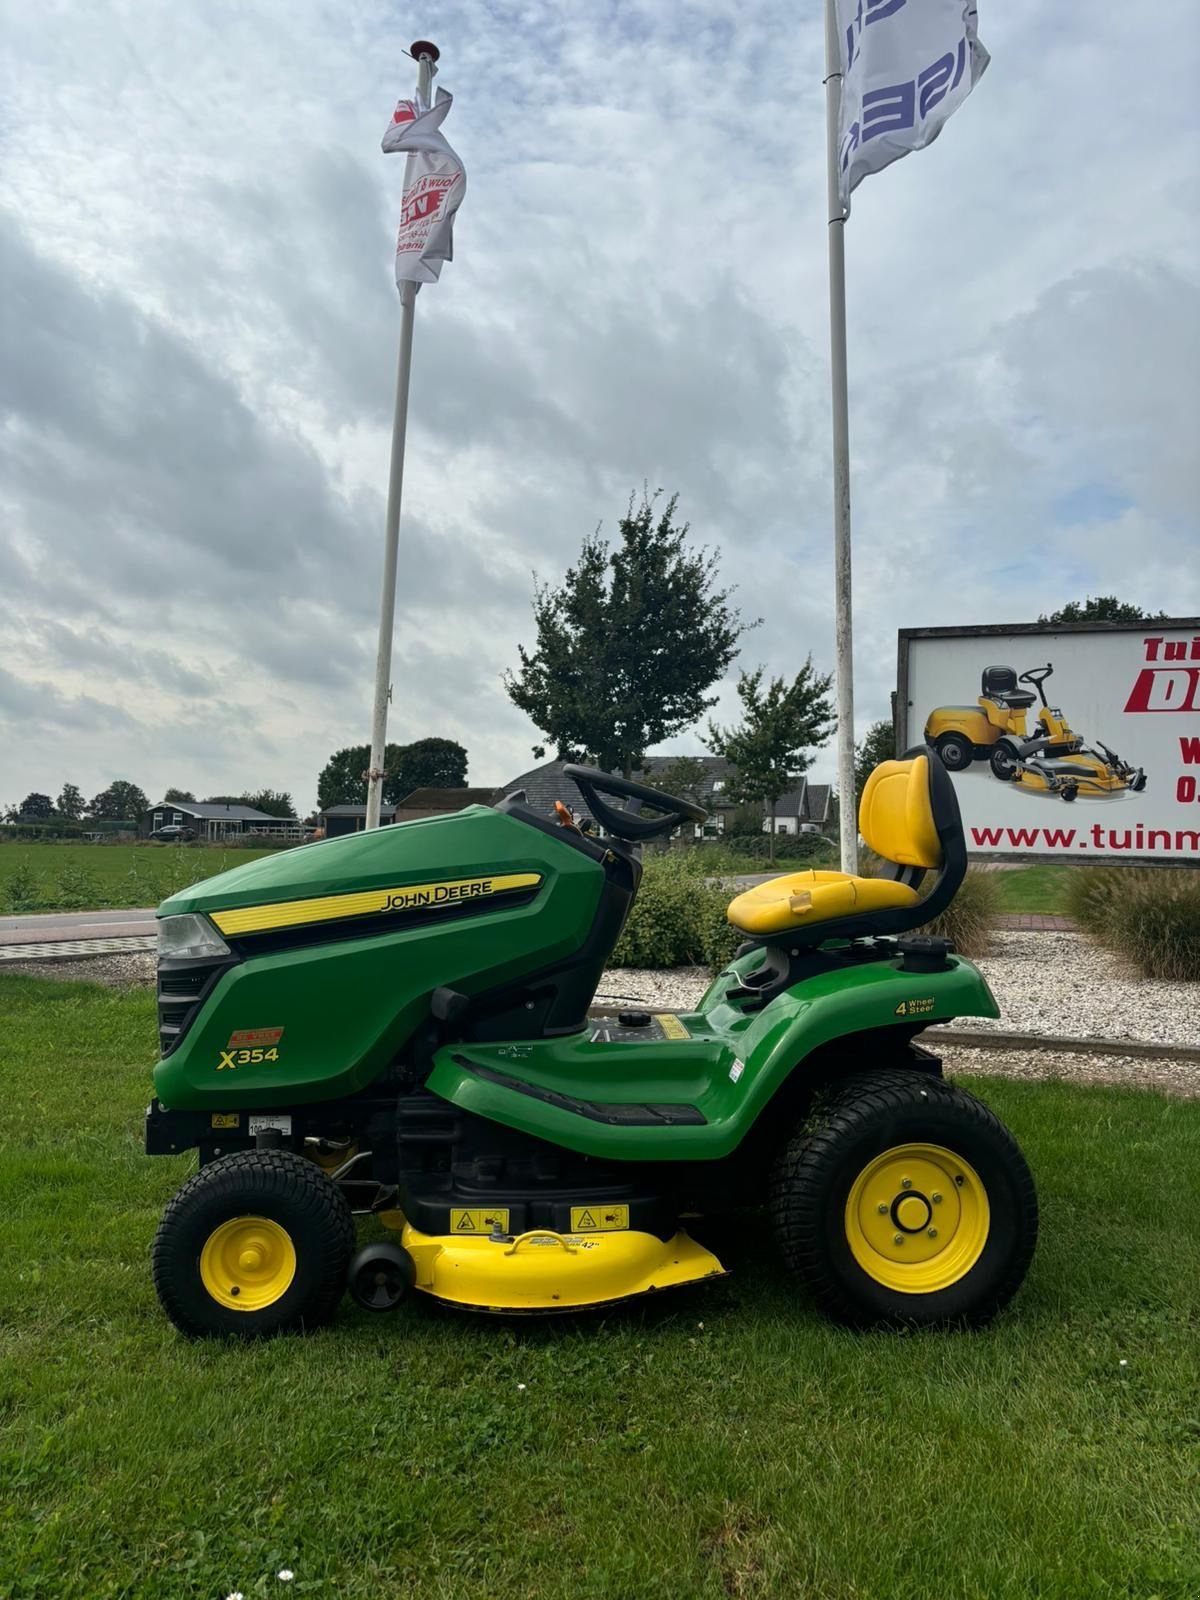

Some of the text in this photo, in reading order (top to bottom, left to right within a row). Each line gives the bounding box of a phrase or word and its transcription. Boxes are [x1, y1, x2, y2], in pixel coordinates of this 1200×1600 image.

[380, 880, 493, 911] JOHN DEERE
[895, 996, 935, 1015] 4 Wheel
[909, 1005, 934, 1014] Steer
[216, 1048, 279, 1070] X354
